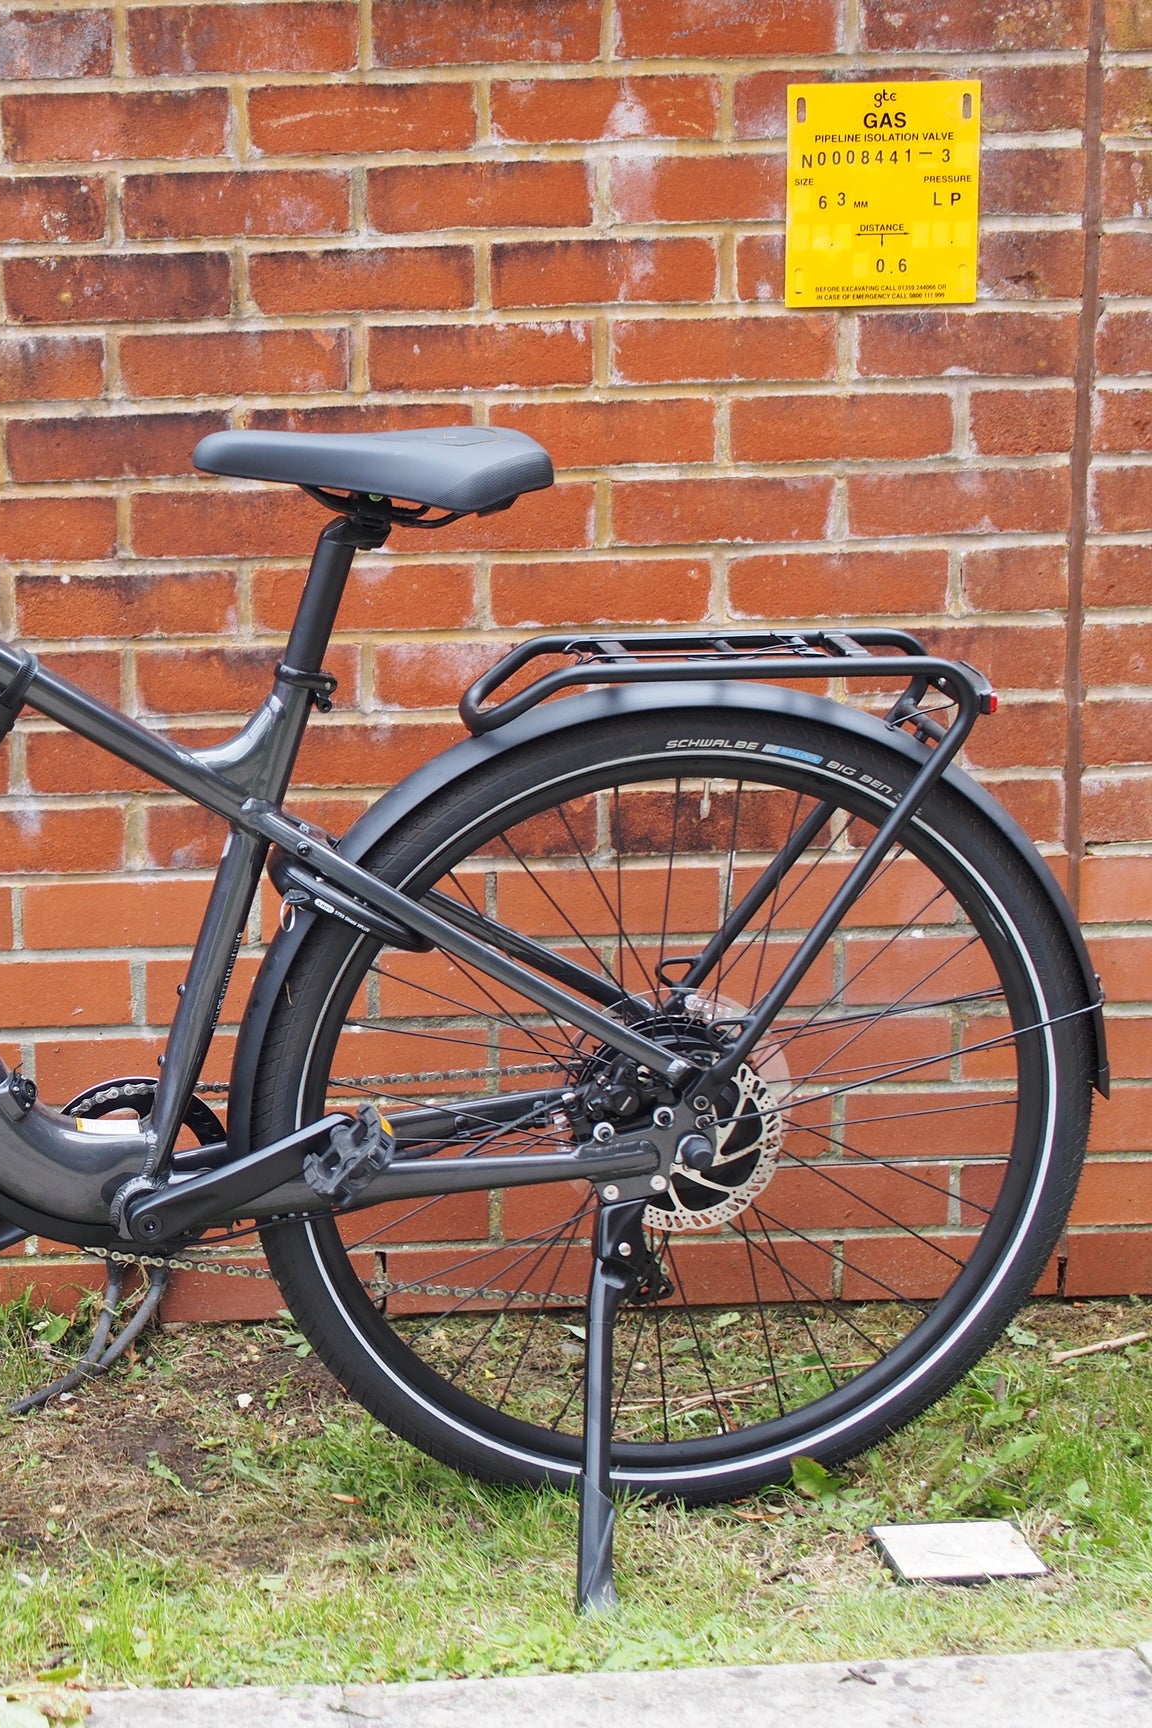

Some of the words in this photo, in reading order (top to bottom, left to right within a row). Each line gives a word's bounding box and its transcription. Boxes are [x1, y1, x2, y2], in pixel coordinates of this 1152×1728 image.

[874, 89, 897, 108] gtc
[863, 112, 907, 129] GAS
[814, 134, 861, 143] PIPELINE
[864, 132, 919, 142] ISOLATION
[922, 132, 954, 141] VALVE
[794, 178, 814, 186] SIZE
[923, 175, 972, 184] PRESSURE
[853, 200, 869, 209] MM
[860, 224, 905, 232] DISTANCE
[665, 738, 759, 751] SCHWALBE
[826, 760, 857, 776] BIG
[858, 774, 893, 794] BEN
